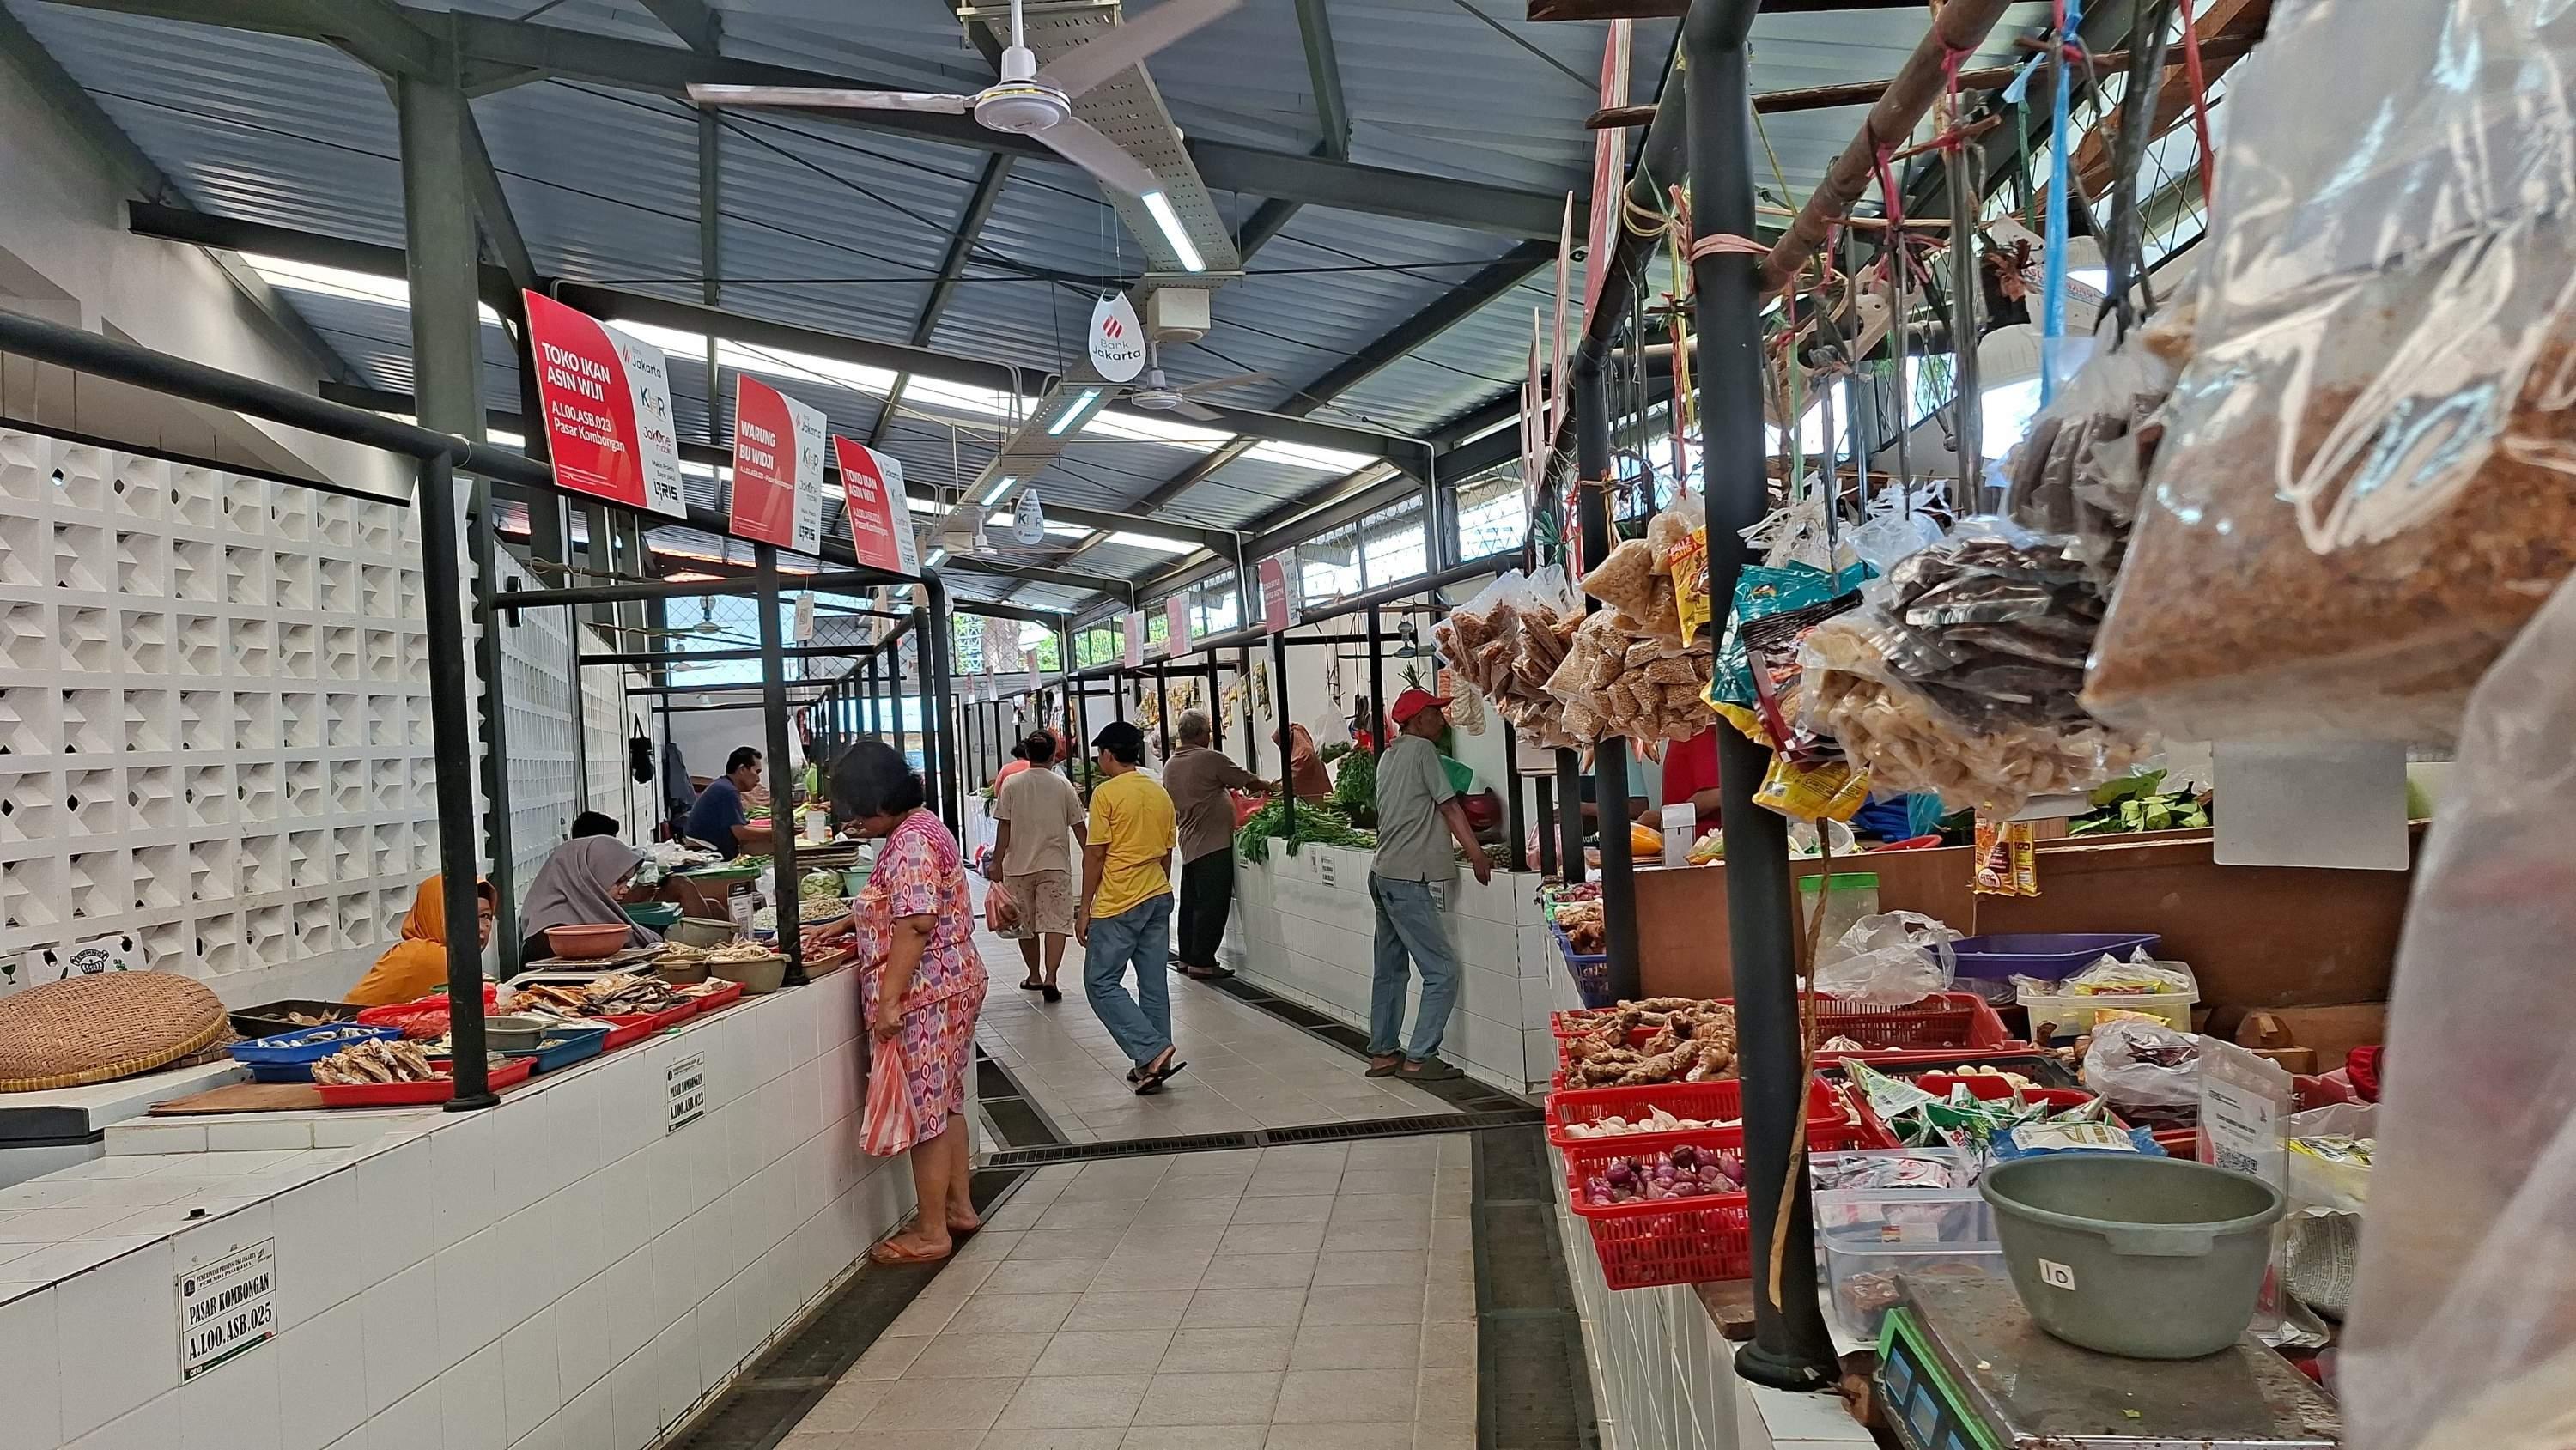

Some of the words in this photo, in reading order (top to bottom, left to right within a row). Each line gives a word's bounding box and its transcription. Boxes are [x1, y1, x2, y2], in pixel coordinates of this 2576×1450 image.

[1092, 346, 1141, 361] Jakarta
[1100, 338, 1128, 349] Bank
[541, 342, 580, 372] TOKO
[580, 356, 611, 385] IKAN
[632, 355, 662, 379] Jakarta
[547, 365, 577, 392] ASIN
[577, 376, 605, 403] WIJI
[554, 416, 578, 437] Pasar
[579, 425, 625, 452] Kombongan
[643, 426, 671, 446] JakOne
[740, 420, 776, 448] WARUNG
[801, 422, 822, 440] Jakarta
[739, 444, 751, 463] BU
[751, 448, 774, 471] WIDJI
[844, 468, 863, 485] TOKO
[653, 481, 678, 501] QRIS
[799, 525, 816, 543] QRIS
[2045, 1262, 2069, 1284] 10
[189, 1296, 216, 1326] PASAR
[219, 1272, 270, 1312] KOMBONGAN
